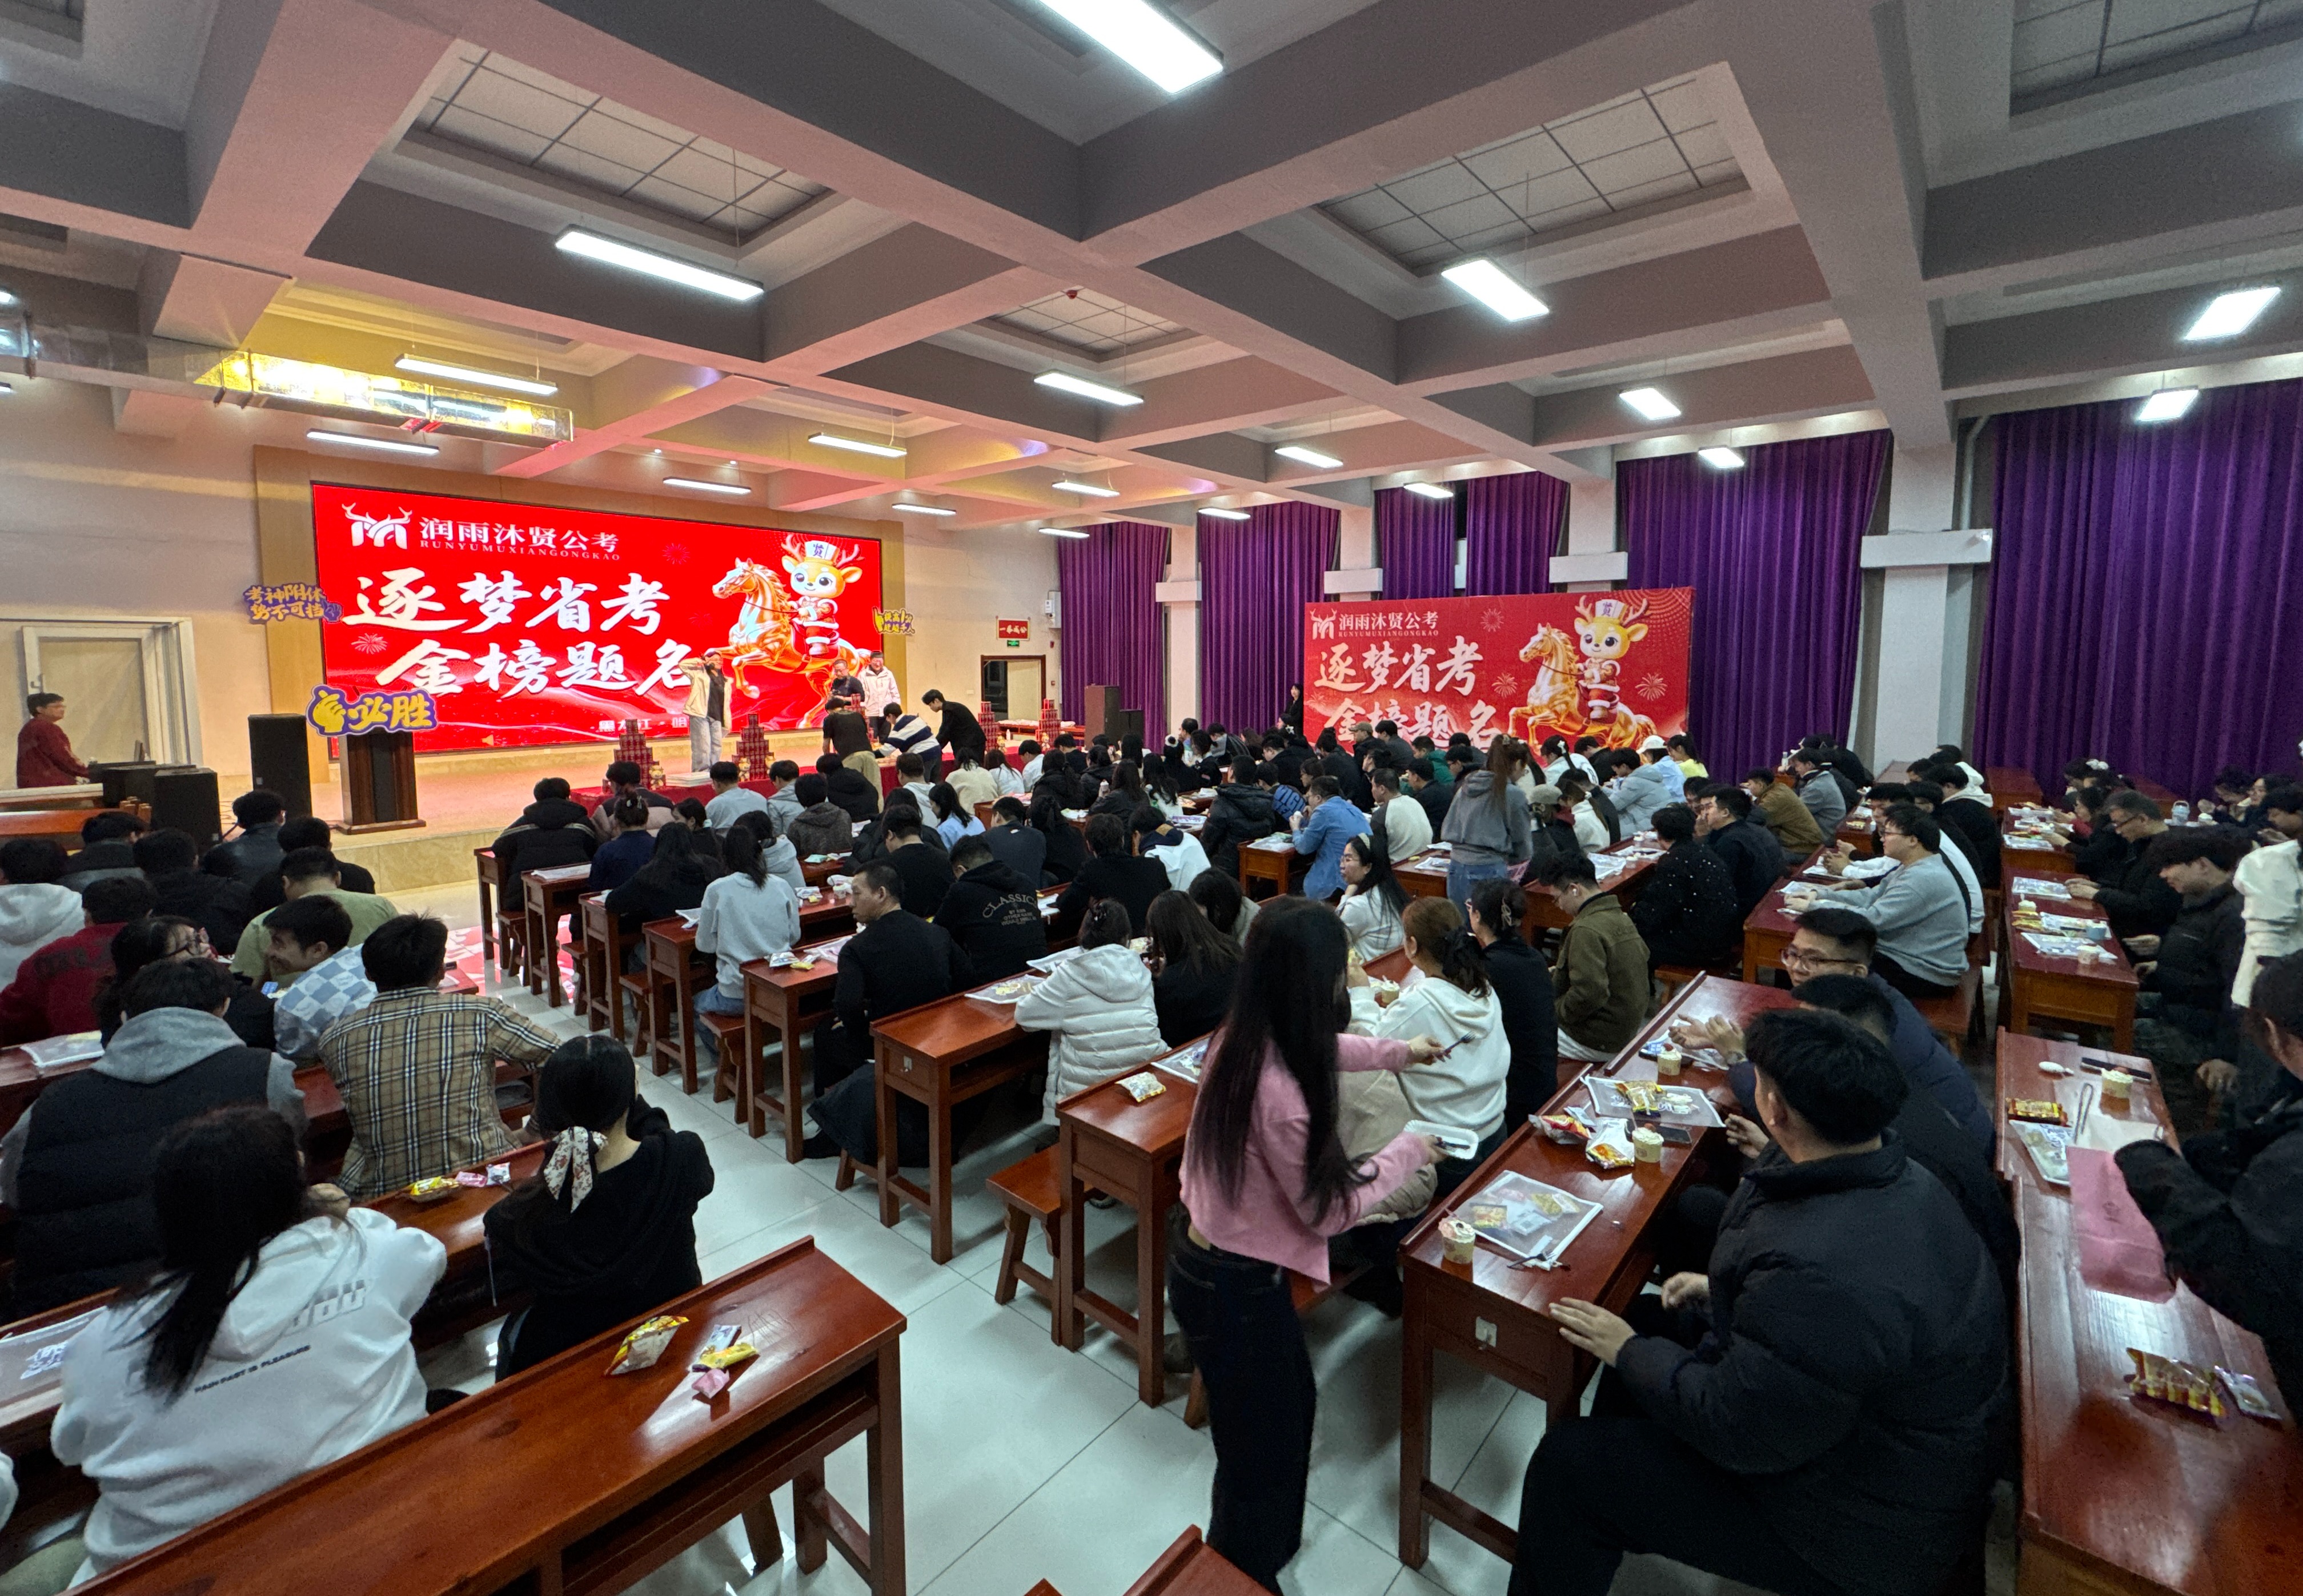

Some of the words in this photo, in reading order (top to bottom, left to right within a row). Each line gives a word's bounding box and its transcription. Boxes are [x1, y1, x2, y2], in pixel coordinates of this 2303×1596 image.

[419, 517, 619, 553] 润雨沐贤公考
[420, 540, 620, 561] RUNYUMUXIANGONGKAO
[342, 566, 670, 635] 逐梦省考
[1339, 611, 1439, 630] 润雨沐贤公考
[375, 639, 692, 699] 金榜题名
[1314, 636, 1483, 696] 逐梦省考
[347, 693, 432, 730] 必胜
